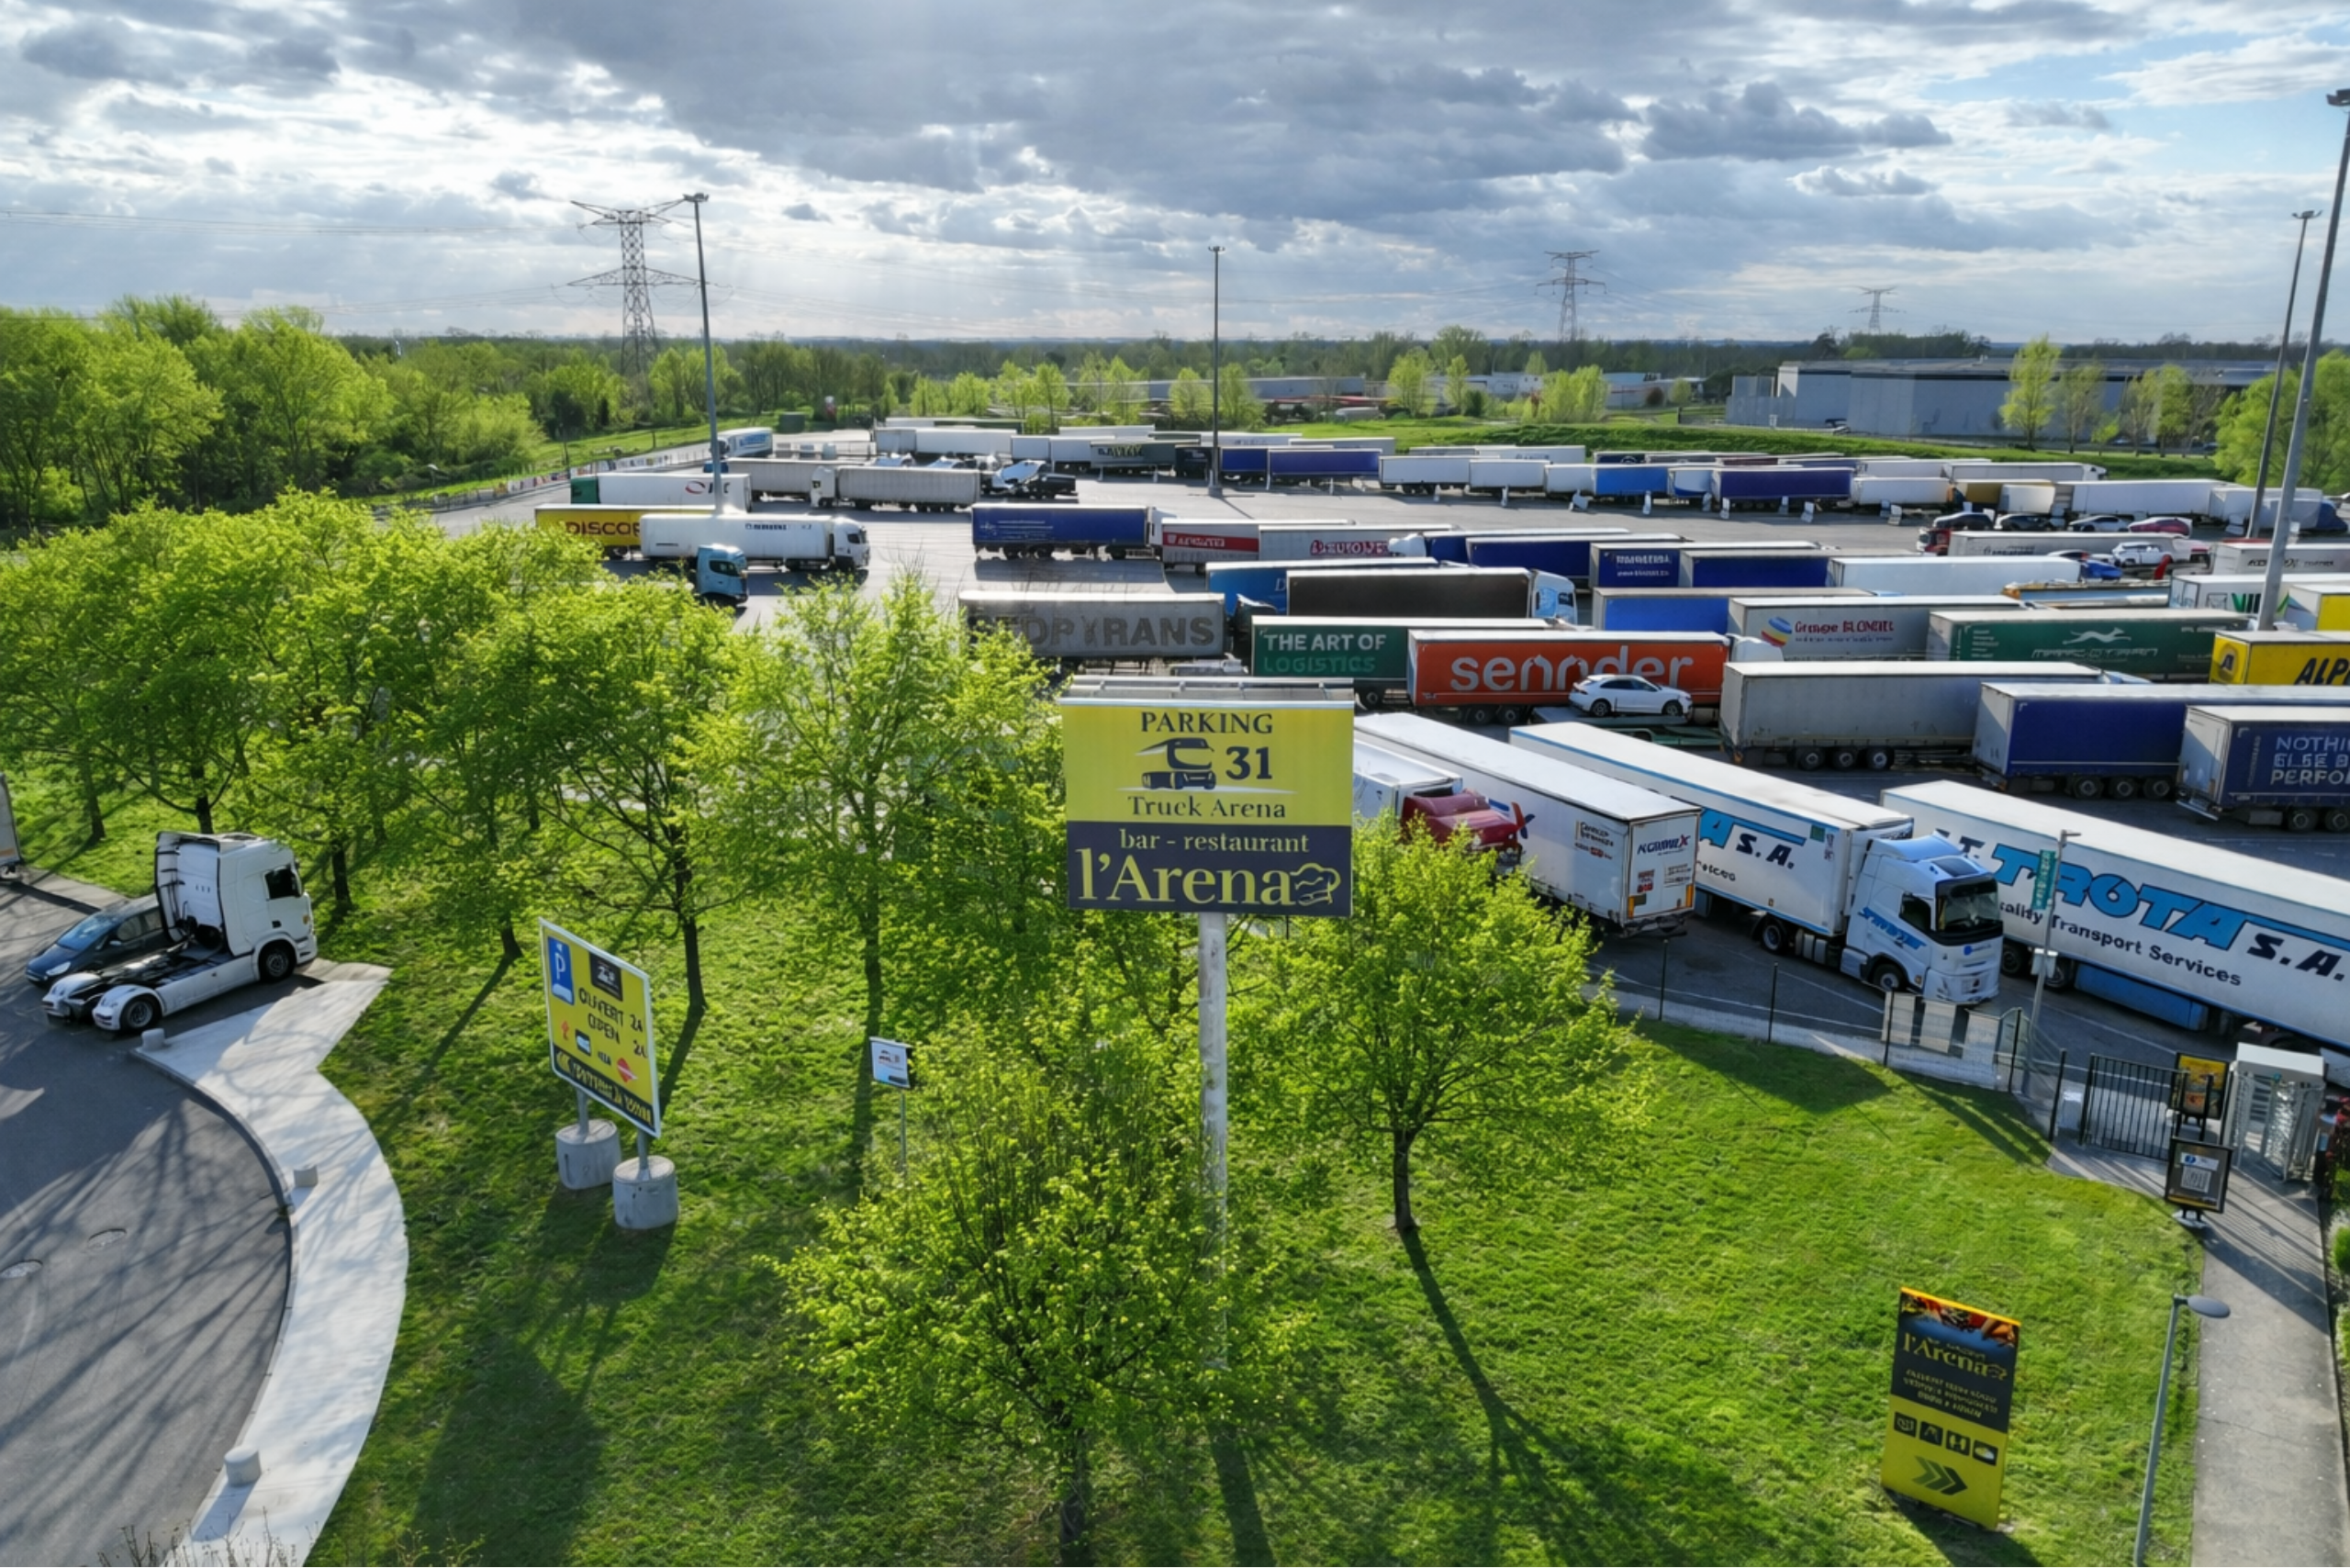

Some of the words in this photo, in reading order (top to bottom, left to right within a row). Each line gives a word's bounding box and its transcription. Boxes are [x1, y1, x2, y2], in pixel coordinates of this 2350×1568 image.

[1263, 633, 1307, 651] THE
[1310, 633, 1354, 652] ART
[1358, 633, 1387, 651] OF
[1262, 655, 1377, 674] LOGISTICS
[1450, 645, 1695, 692] sennder
[1140, 711, 1274, 734] PARKING
[2276, 735, 2350, 752] NOTHI
[1225, 746, 1273, 780] 31
[2273, 753, 2328, 768] ELSE
[2334, 753, 2350, 767] B
[1127, 796, 1203, 817] Truck
[1210, 798, 1286, 818] Arena
[1119, 828, 1160, 849] bar
[1183, 833, 1310, 853] restaurant
[1736, 833, 1796, 869] S.A.
[1075, 847, 1295, 906] l'Arena
[1991, 842, 2248, 951] TROTA
[2247, 932, 2346, 981] S.A.
[2051, 914, 2142, 955] Transport
[2149, 945, 2242, 987] Services
